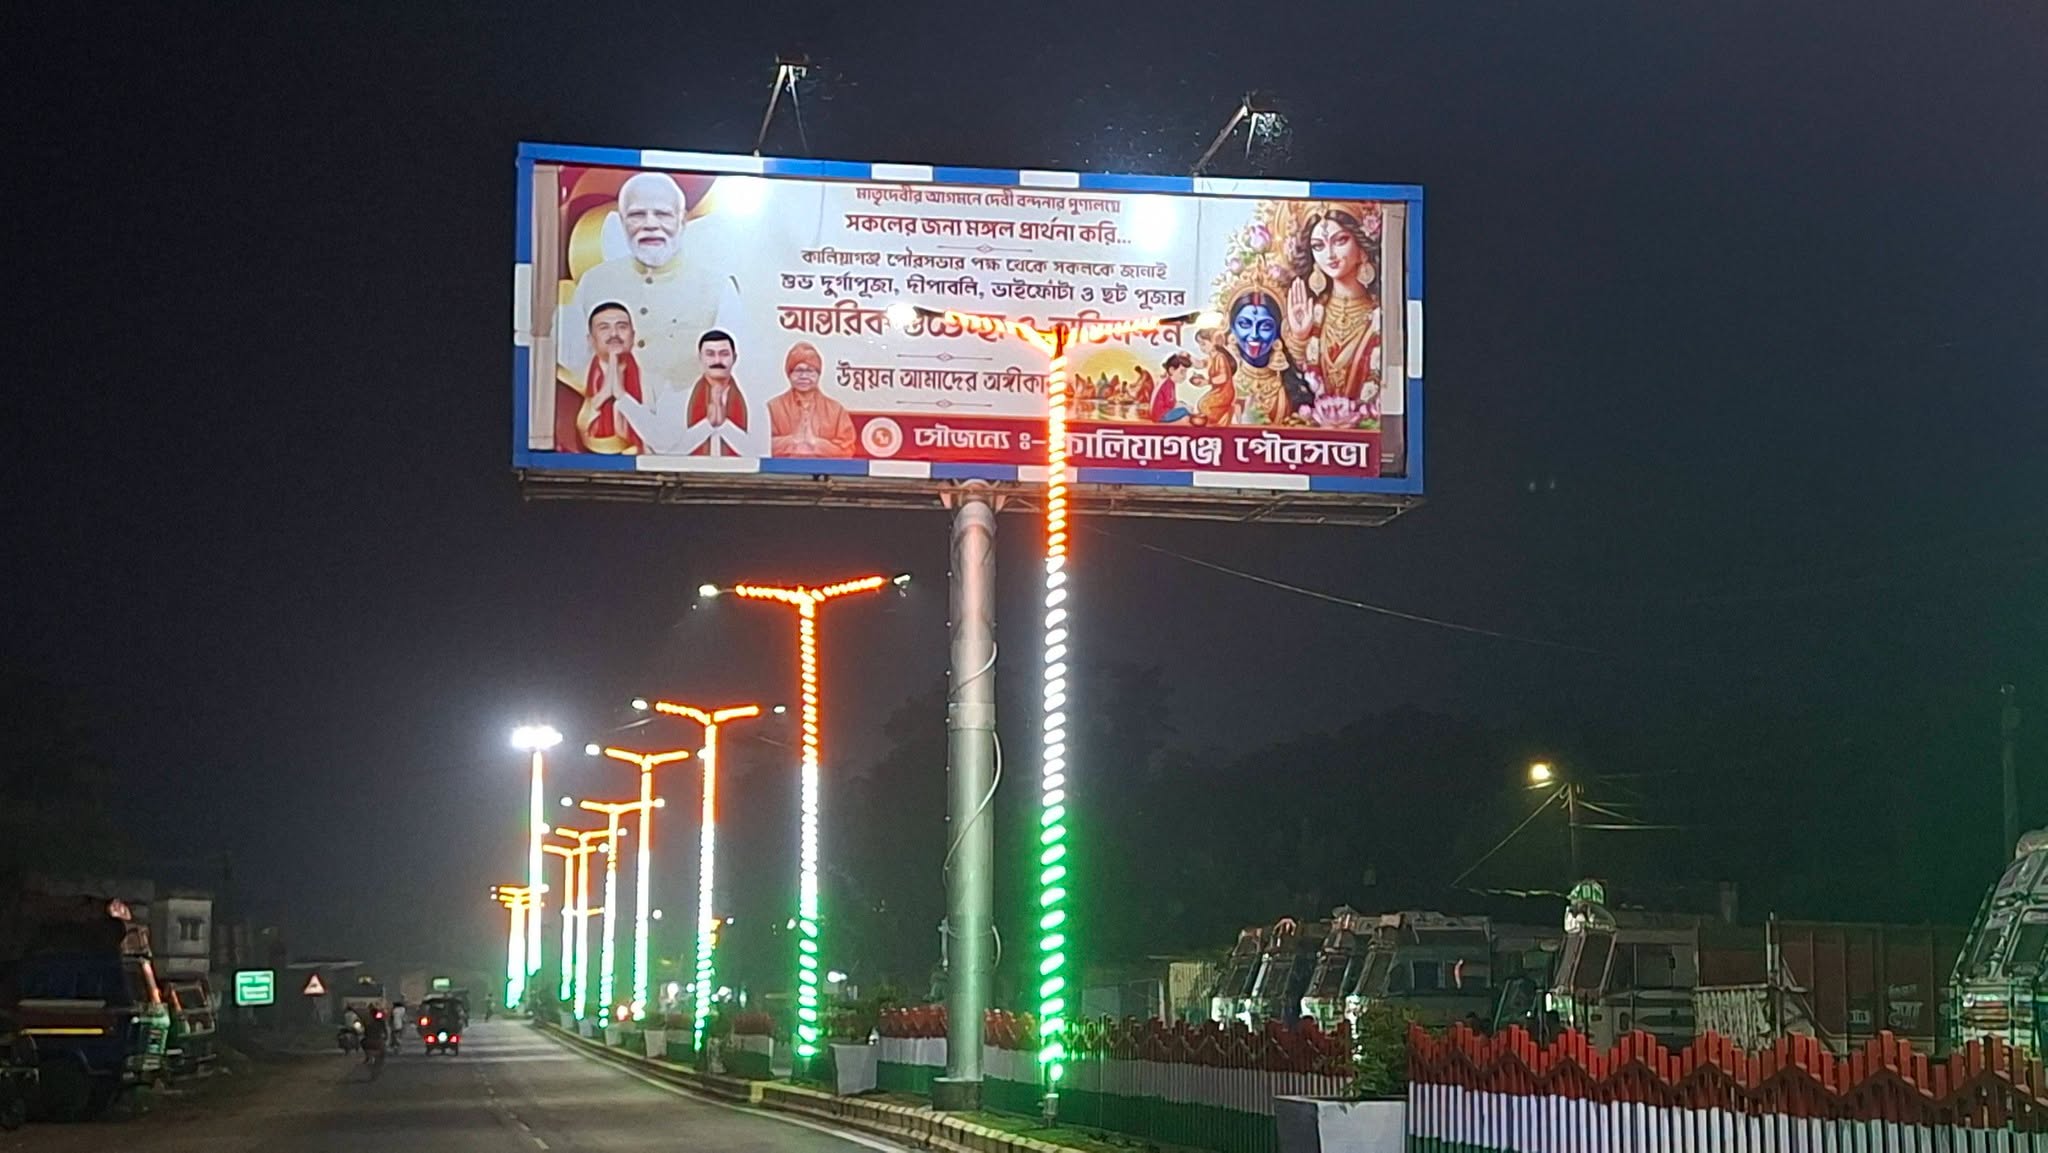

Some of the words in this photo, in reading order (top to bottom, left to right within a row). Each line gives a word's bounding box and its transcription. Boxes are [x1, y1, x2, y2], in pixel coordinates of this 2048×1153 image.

[925, 191, 982, 206] আগমনে
[985, 188, 1014, 208] দেবী
[1017, 197, 1065, 211] বন্দনার
[845, 213, 917, 236] সকলের
[921, 218, 961, 237] জন্য
[965, 219, 1014, 239] মঙ্গল
[1019, 216, 1075, 242] প্রার্থনা
[802, 247, 881, 267] কালিয়াগঞ্জ
[887, 247, 966, 270] পৌরসভার
[971, 256, 1002, 271] পক্ষ
[1006, 258, 1047, 274] থেকে
[1053, 260, 1114, 277] সকলকে
[1120, 261, 1168, 280] জানাই
[781, 273, 816, 290] শুভ
[820, 271, 899, 299] দুর্গাপূজা,
[906, 273, 985, 300] দীপাবলি,
[991, 278, 1075, 301] ভাইফোঁটা
[1081, 287, 1094, 302] ও
[1101, 283, 1128, 303] ছট
[1134, 289, 1186, 310] পূজার
[777, 299, 890, 336] আন্তরিক
[836, 361, 895, 392] উন্নয়ন
[899, 368, 978, 392] আমাদের
[983, 366, 1050, 394] অঙ্গীকা
[913, 423, 1011, 450] সৌজন্যে
[1234, 430, 1370, 469] পৌরসভা
